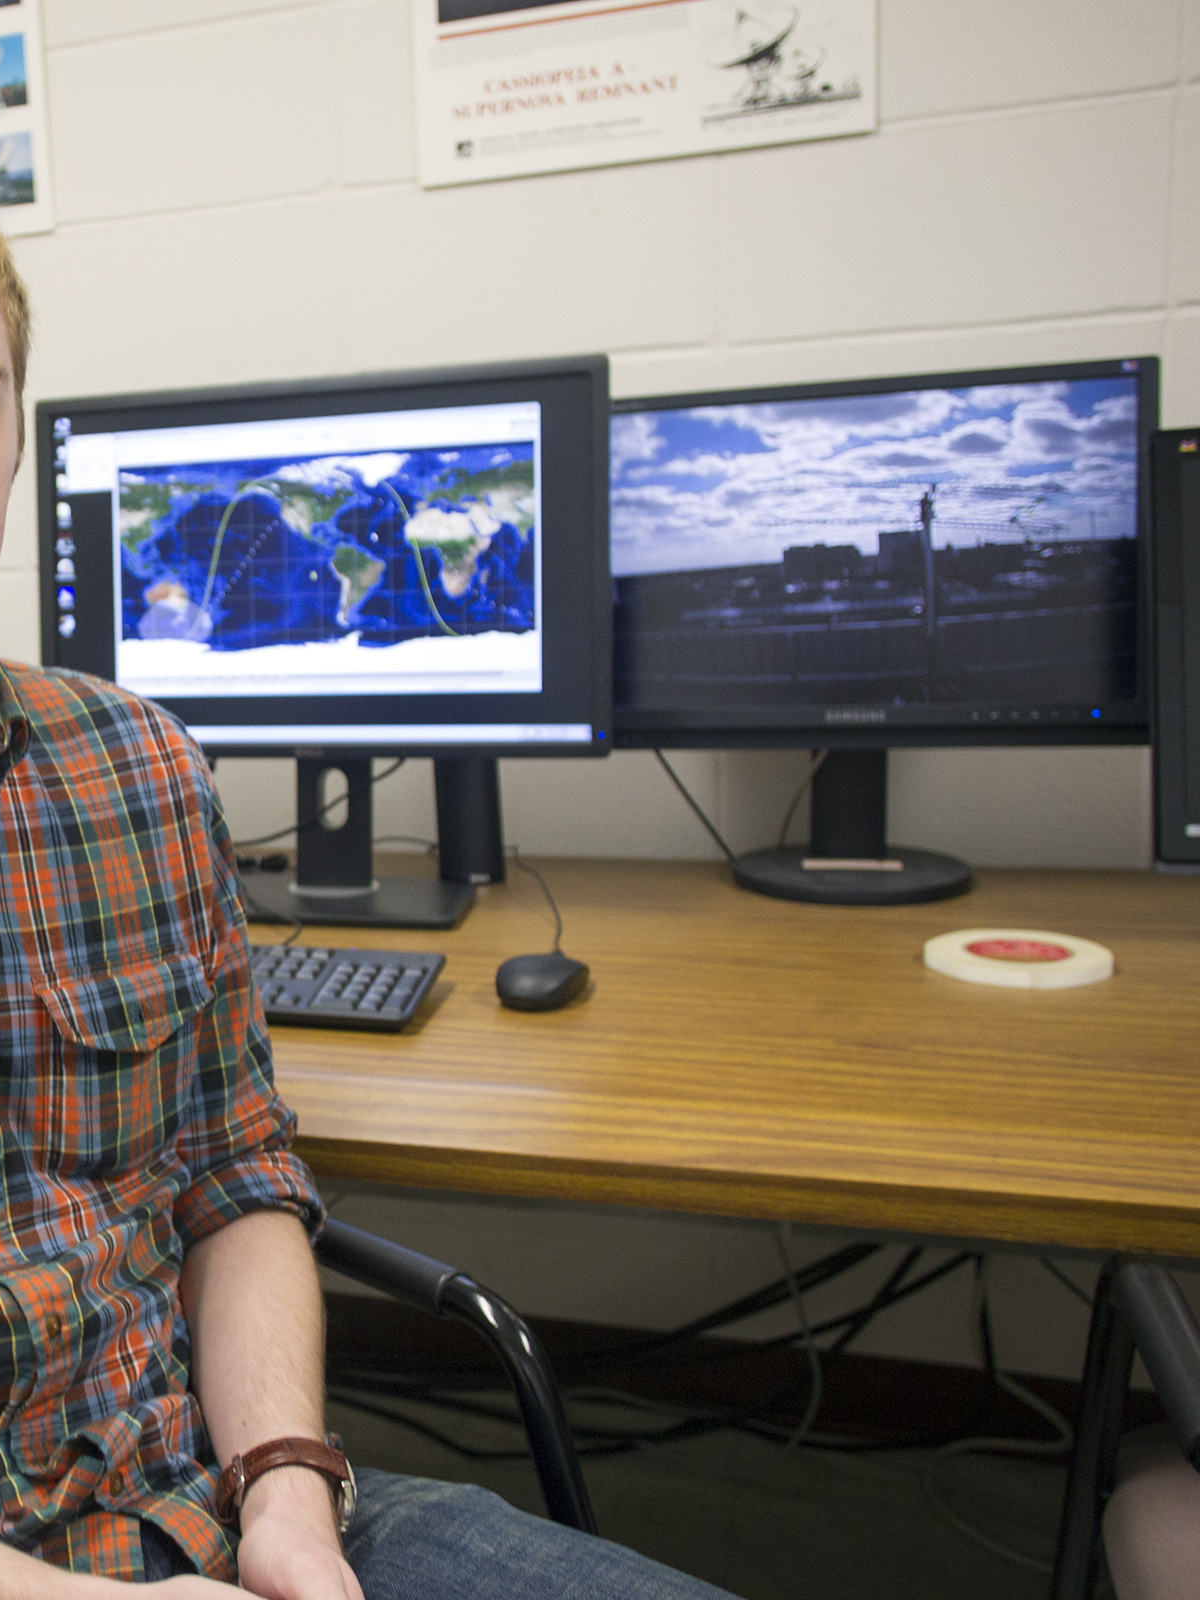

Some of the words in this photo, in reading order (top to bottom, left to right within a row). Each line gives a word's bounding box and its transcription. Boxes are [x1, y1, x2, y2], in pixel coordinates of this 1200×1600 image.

[483, 65, 599, 95] CASSIOPEIA
[610, 61, 625, 77] A
[452, 91, 566, 121] SUPERNOVA
[576, 74, 678, 104] REMNANT
[824, 708, 887, 724] SAMSUNG
